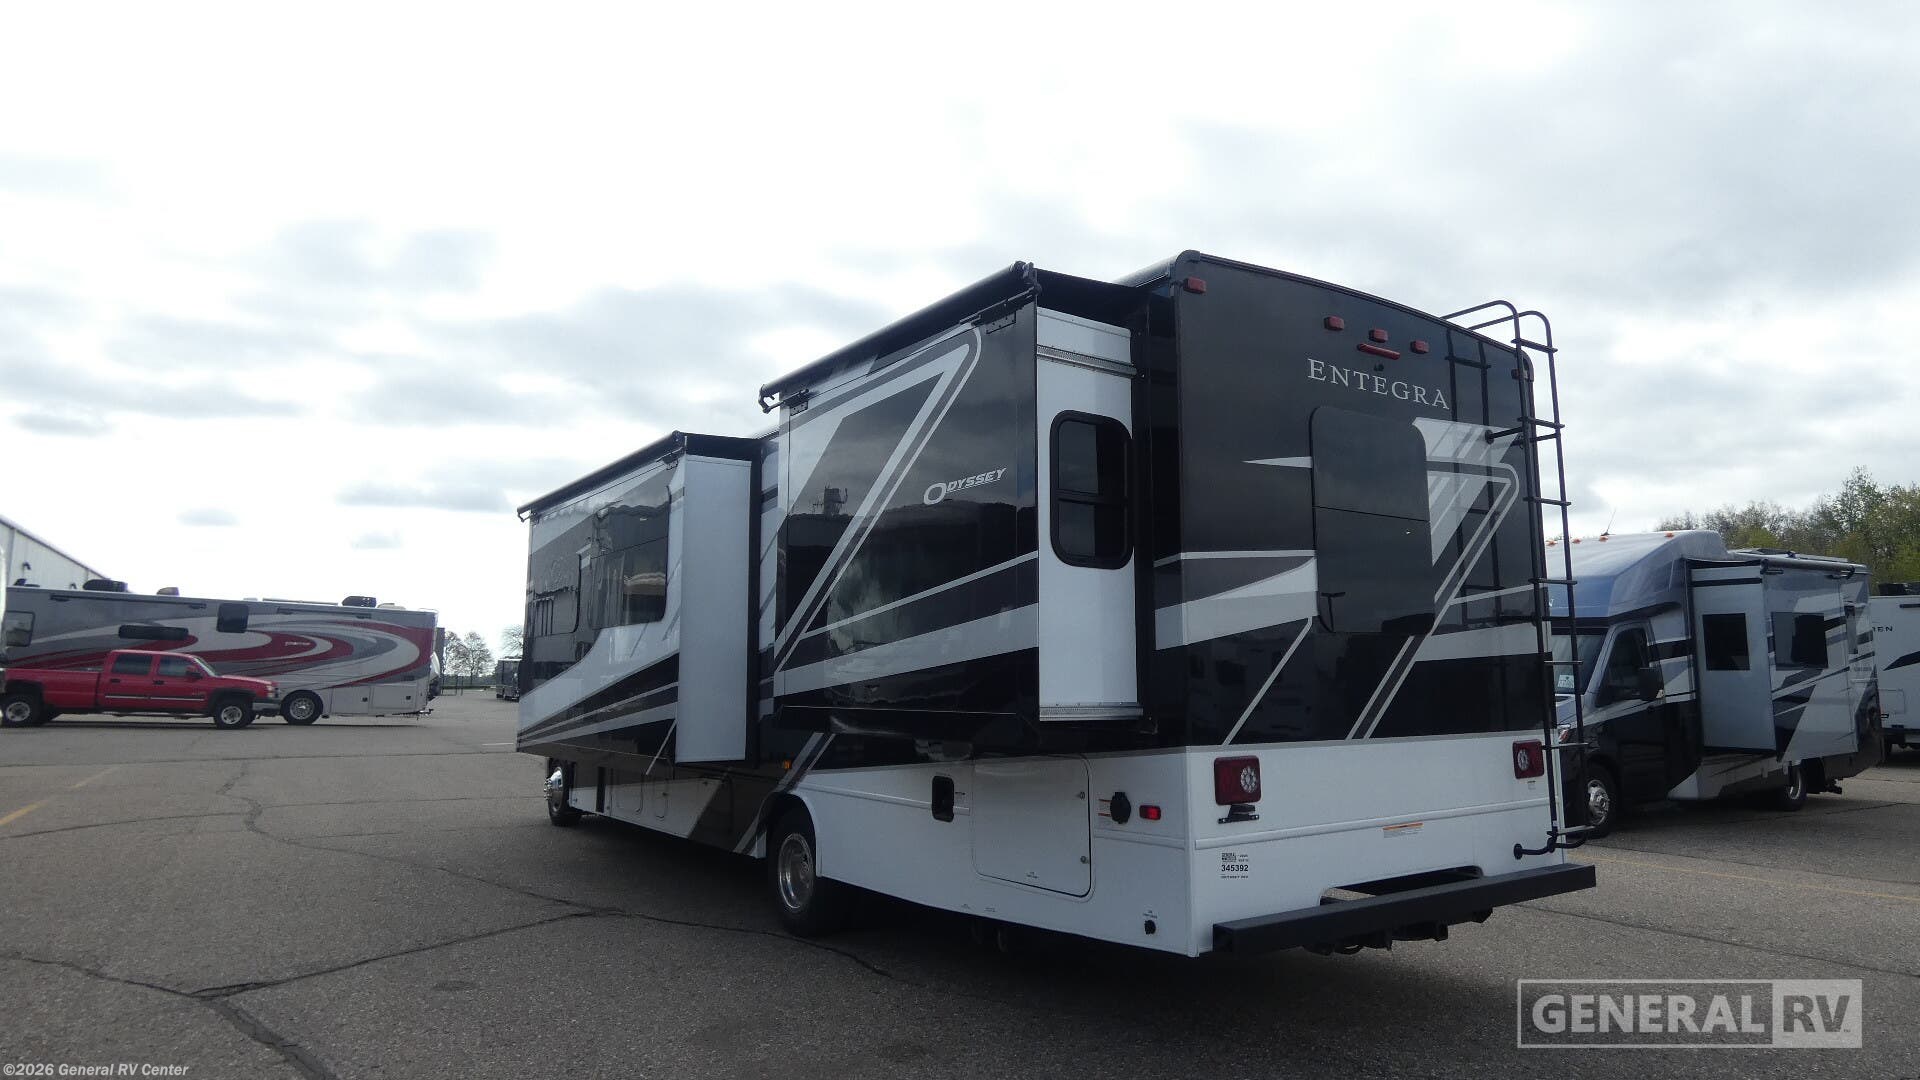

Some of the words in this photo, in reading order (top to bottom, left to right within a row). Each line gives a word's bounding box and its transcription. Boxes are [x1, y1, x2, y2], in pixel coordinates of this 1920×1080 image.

[1307, 358, 1450, 410] ENTEGRA
[923, 467, 1007, 506] ODYSSEY
[1221, 864, 1249, 872] 345392
